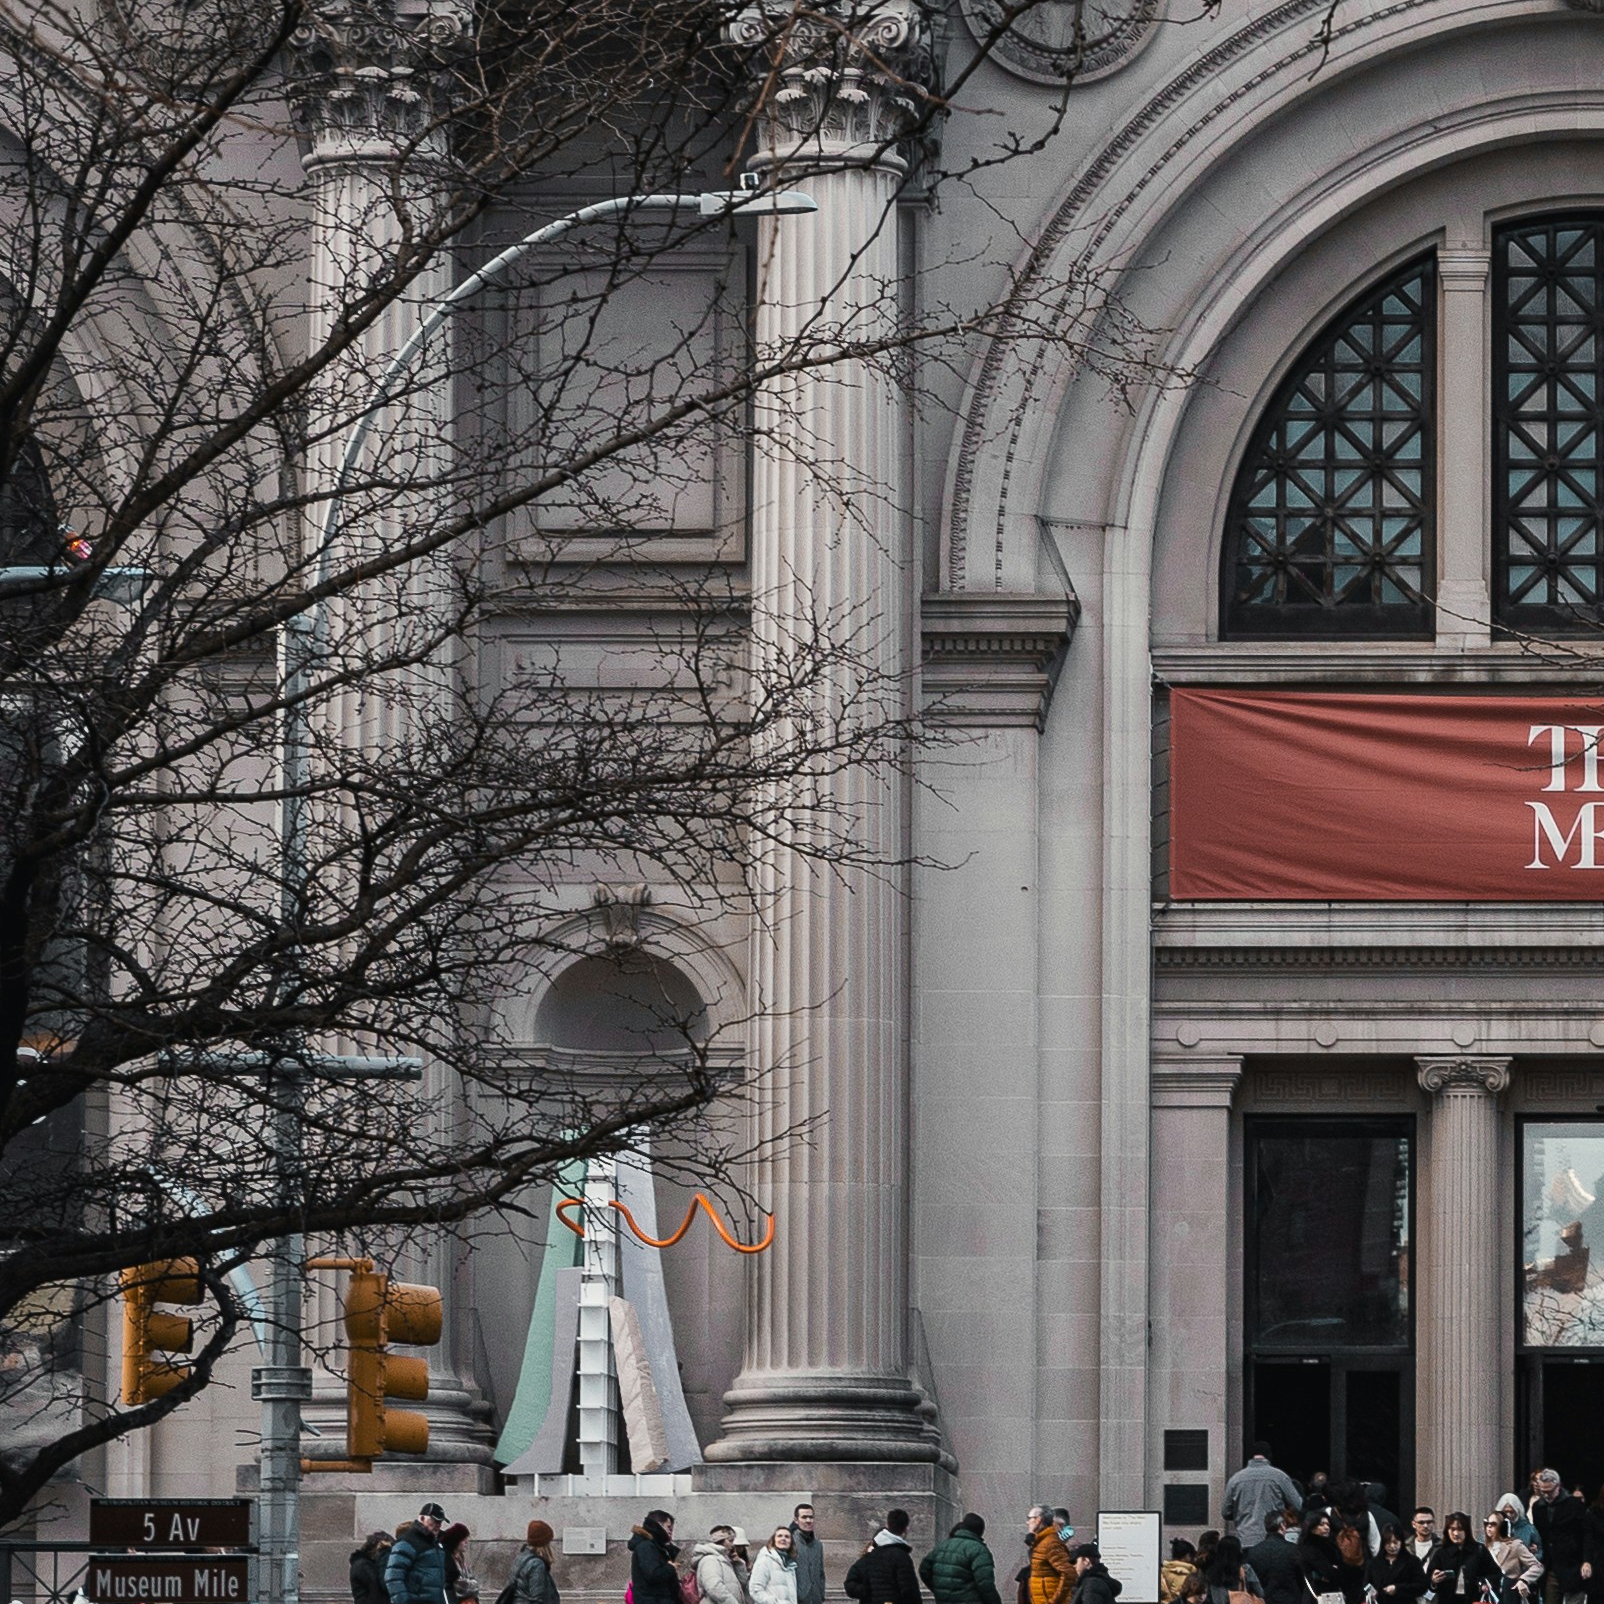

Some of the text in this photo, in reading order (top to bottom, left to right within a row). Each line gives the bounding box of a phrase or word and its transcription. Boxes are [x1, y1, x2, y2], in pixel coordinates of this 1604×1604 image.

[143, 1513, 200, 1542] 5 Av
[96, 1568, 239, 1597] Museum Mile
